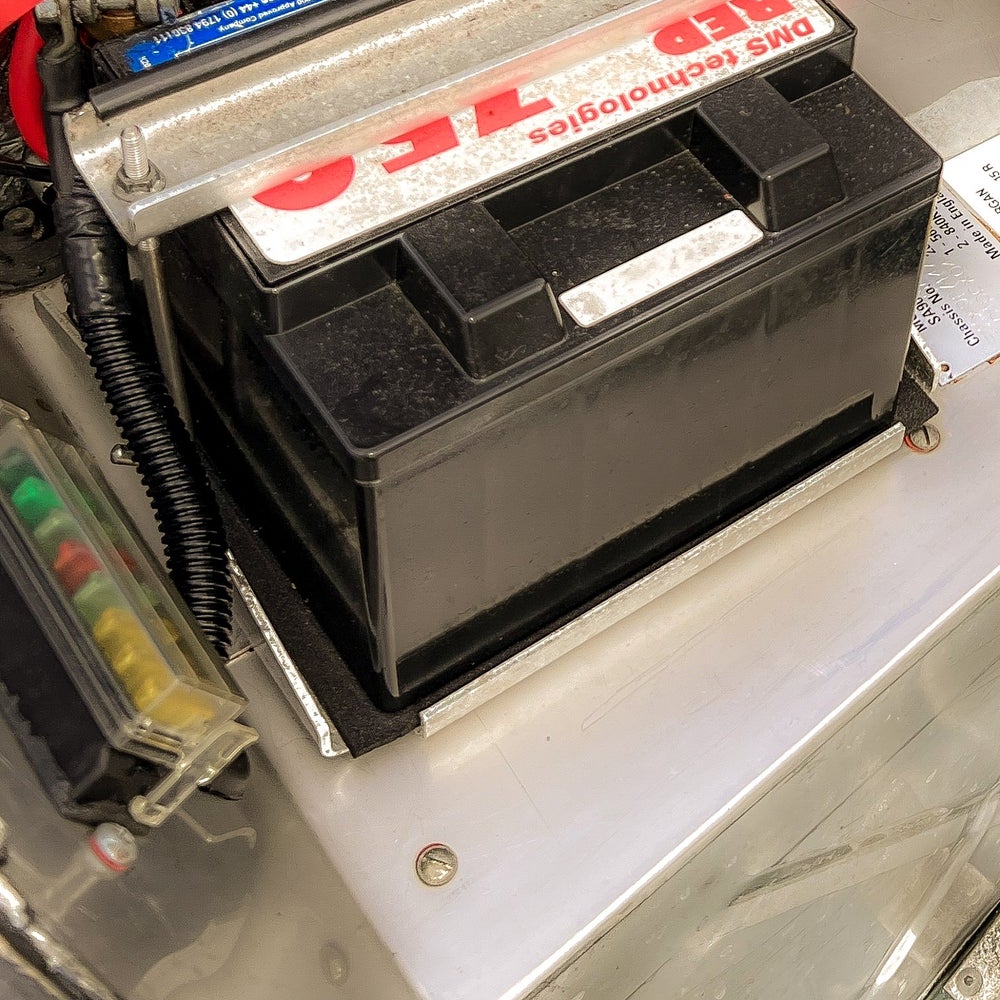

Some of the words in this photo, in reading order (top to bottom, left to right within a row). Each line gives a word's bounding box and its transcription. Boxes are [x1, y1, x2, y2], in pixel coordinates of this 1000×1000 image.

[192, 11, 221, 30] 1794
[220, 5, 238, 20] (0)
[746, 18, 814, 56] DMS
[528, 49, 738, 144] technologies
[961, 219, 973, 230] in
[957, 240, 969, 249] 2
[972, 231, 1000, 259] Made
[926, 284, 942, 303] No.
[941, 304, 979, 346] Chassis
